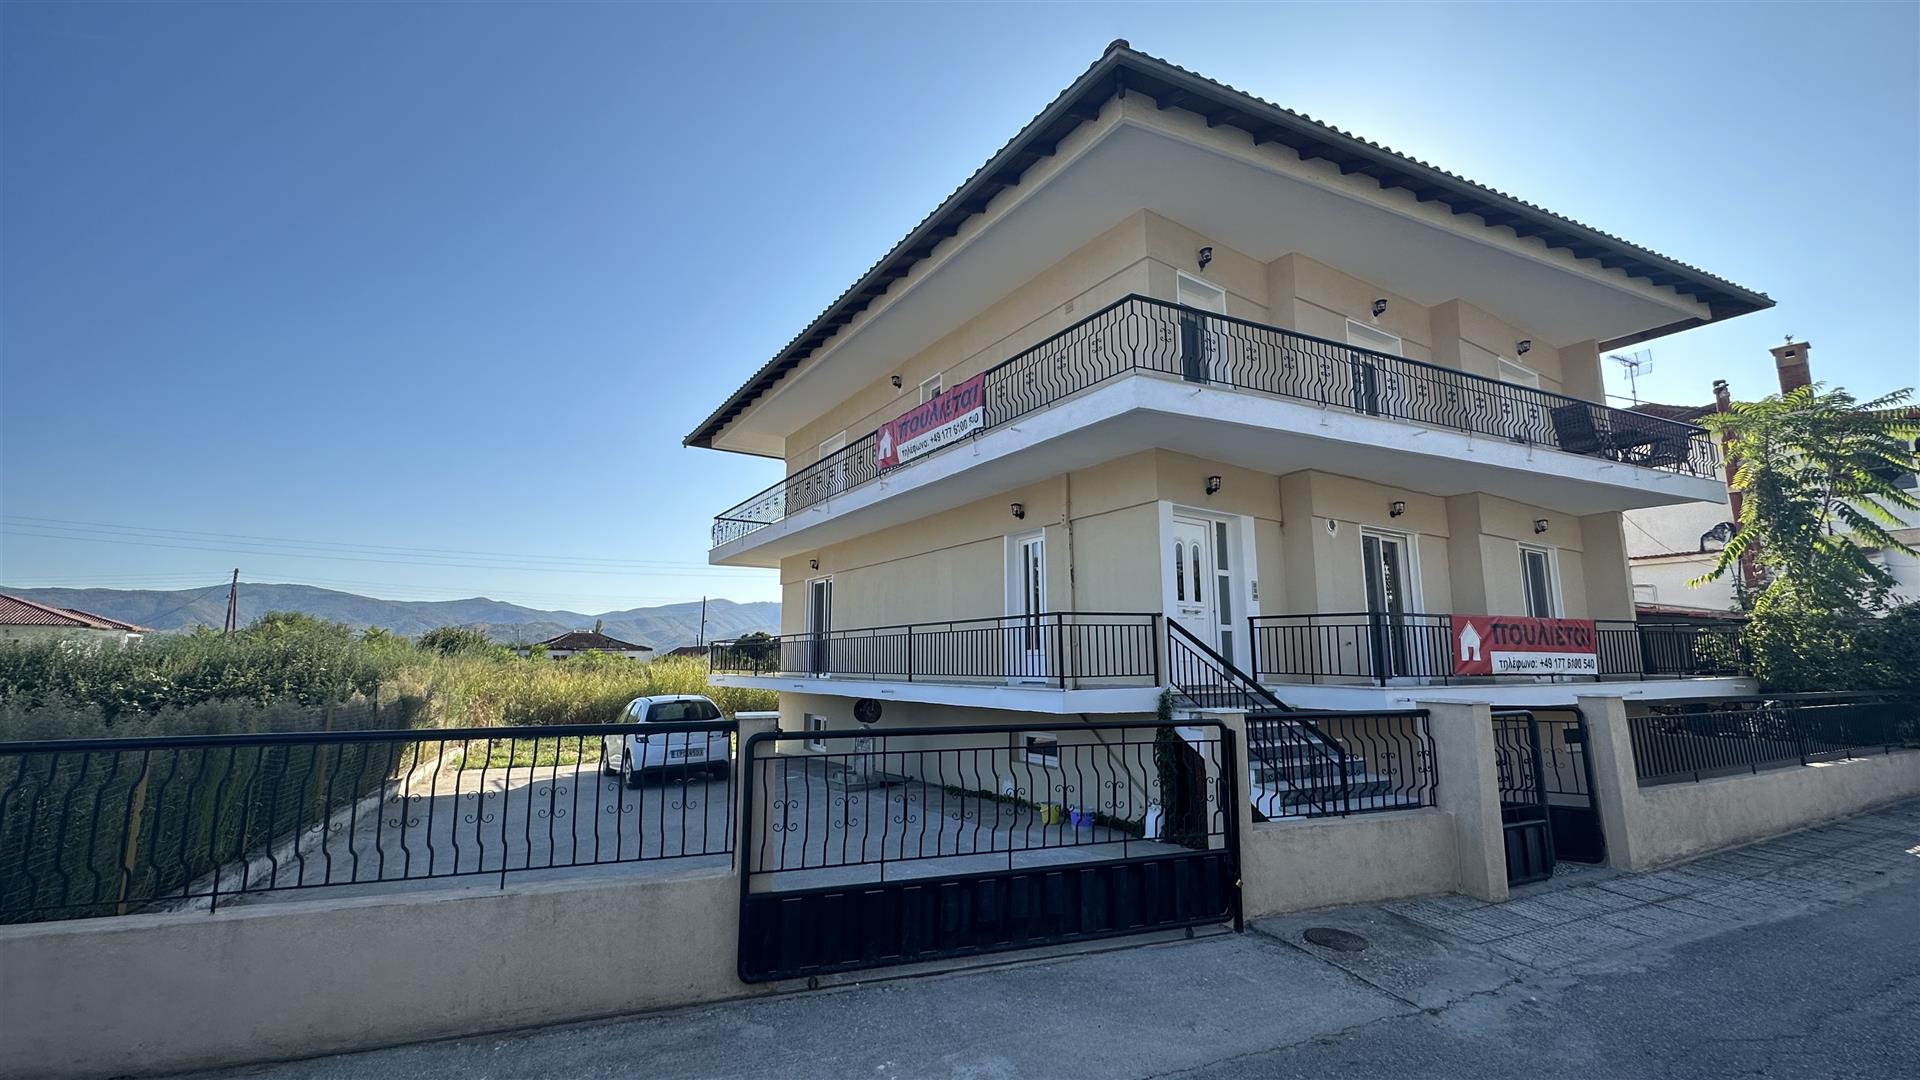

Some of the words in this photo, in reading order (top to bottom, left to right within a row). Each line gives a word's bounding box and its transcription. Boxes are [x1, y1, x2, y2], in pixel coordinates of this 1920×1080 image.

[930, 431, 941, 443] +49
[941, 427, 952, 440] 177
[1499, 657, 1538, 671] τηλέφωνο:
[1540, 658, 1553, 669] +49
[1554, 658, 1565, 669] 177
[1583, 658, 1595, 670] 540
